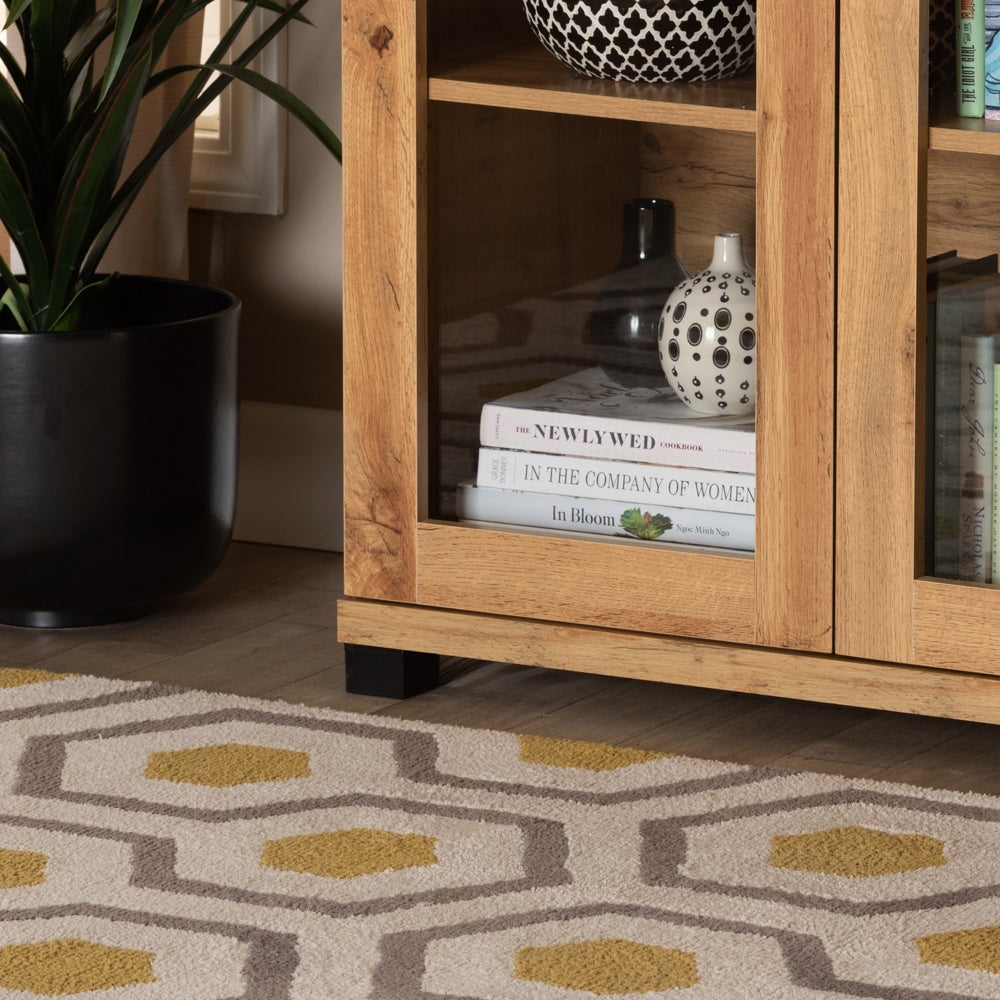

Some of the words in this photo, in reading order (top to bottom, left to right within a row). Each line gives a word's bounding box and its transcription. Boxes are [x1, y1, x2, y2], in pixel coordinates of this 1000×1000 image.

[961, 44, 975, 63] GIRL
[961, 65, 975, 87] IDIOT
[961, 87, 975, 104] THE
[967, 361, 986, 405] Dear
[515, 426, 531, 434] THE
[533, 424, 656, 450] NEWLYWED
[659, 441, 704, 452] COOKBOOK
[961, 405, 986, 458] John
[491, 459, 499, 481] GRACE
[499, 455, 509, 484] BONNEY
[524, 464, 542, 481] IN
[547, 466, 580, 486] THE
[585, 470, 664, 495] COMPANY
[667, 479, 690, 497] OF
[694, 482, 756, 504] WOMEN
[552, 505, 567, 522] In
[571, 507, 615, 527] Bloom
[676, 524, 694, 534] Ngoc
[695, 525, 714, 535] Minh
[715, 527, 730, 537] Ngo
